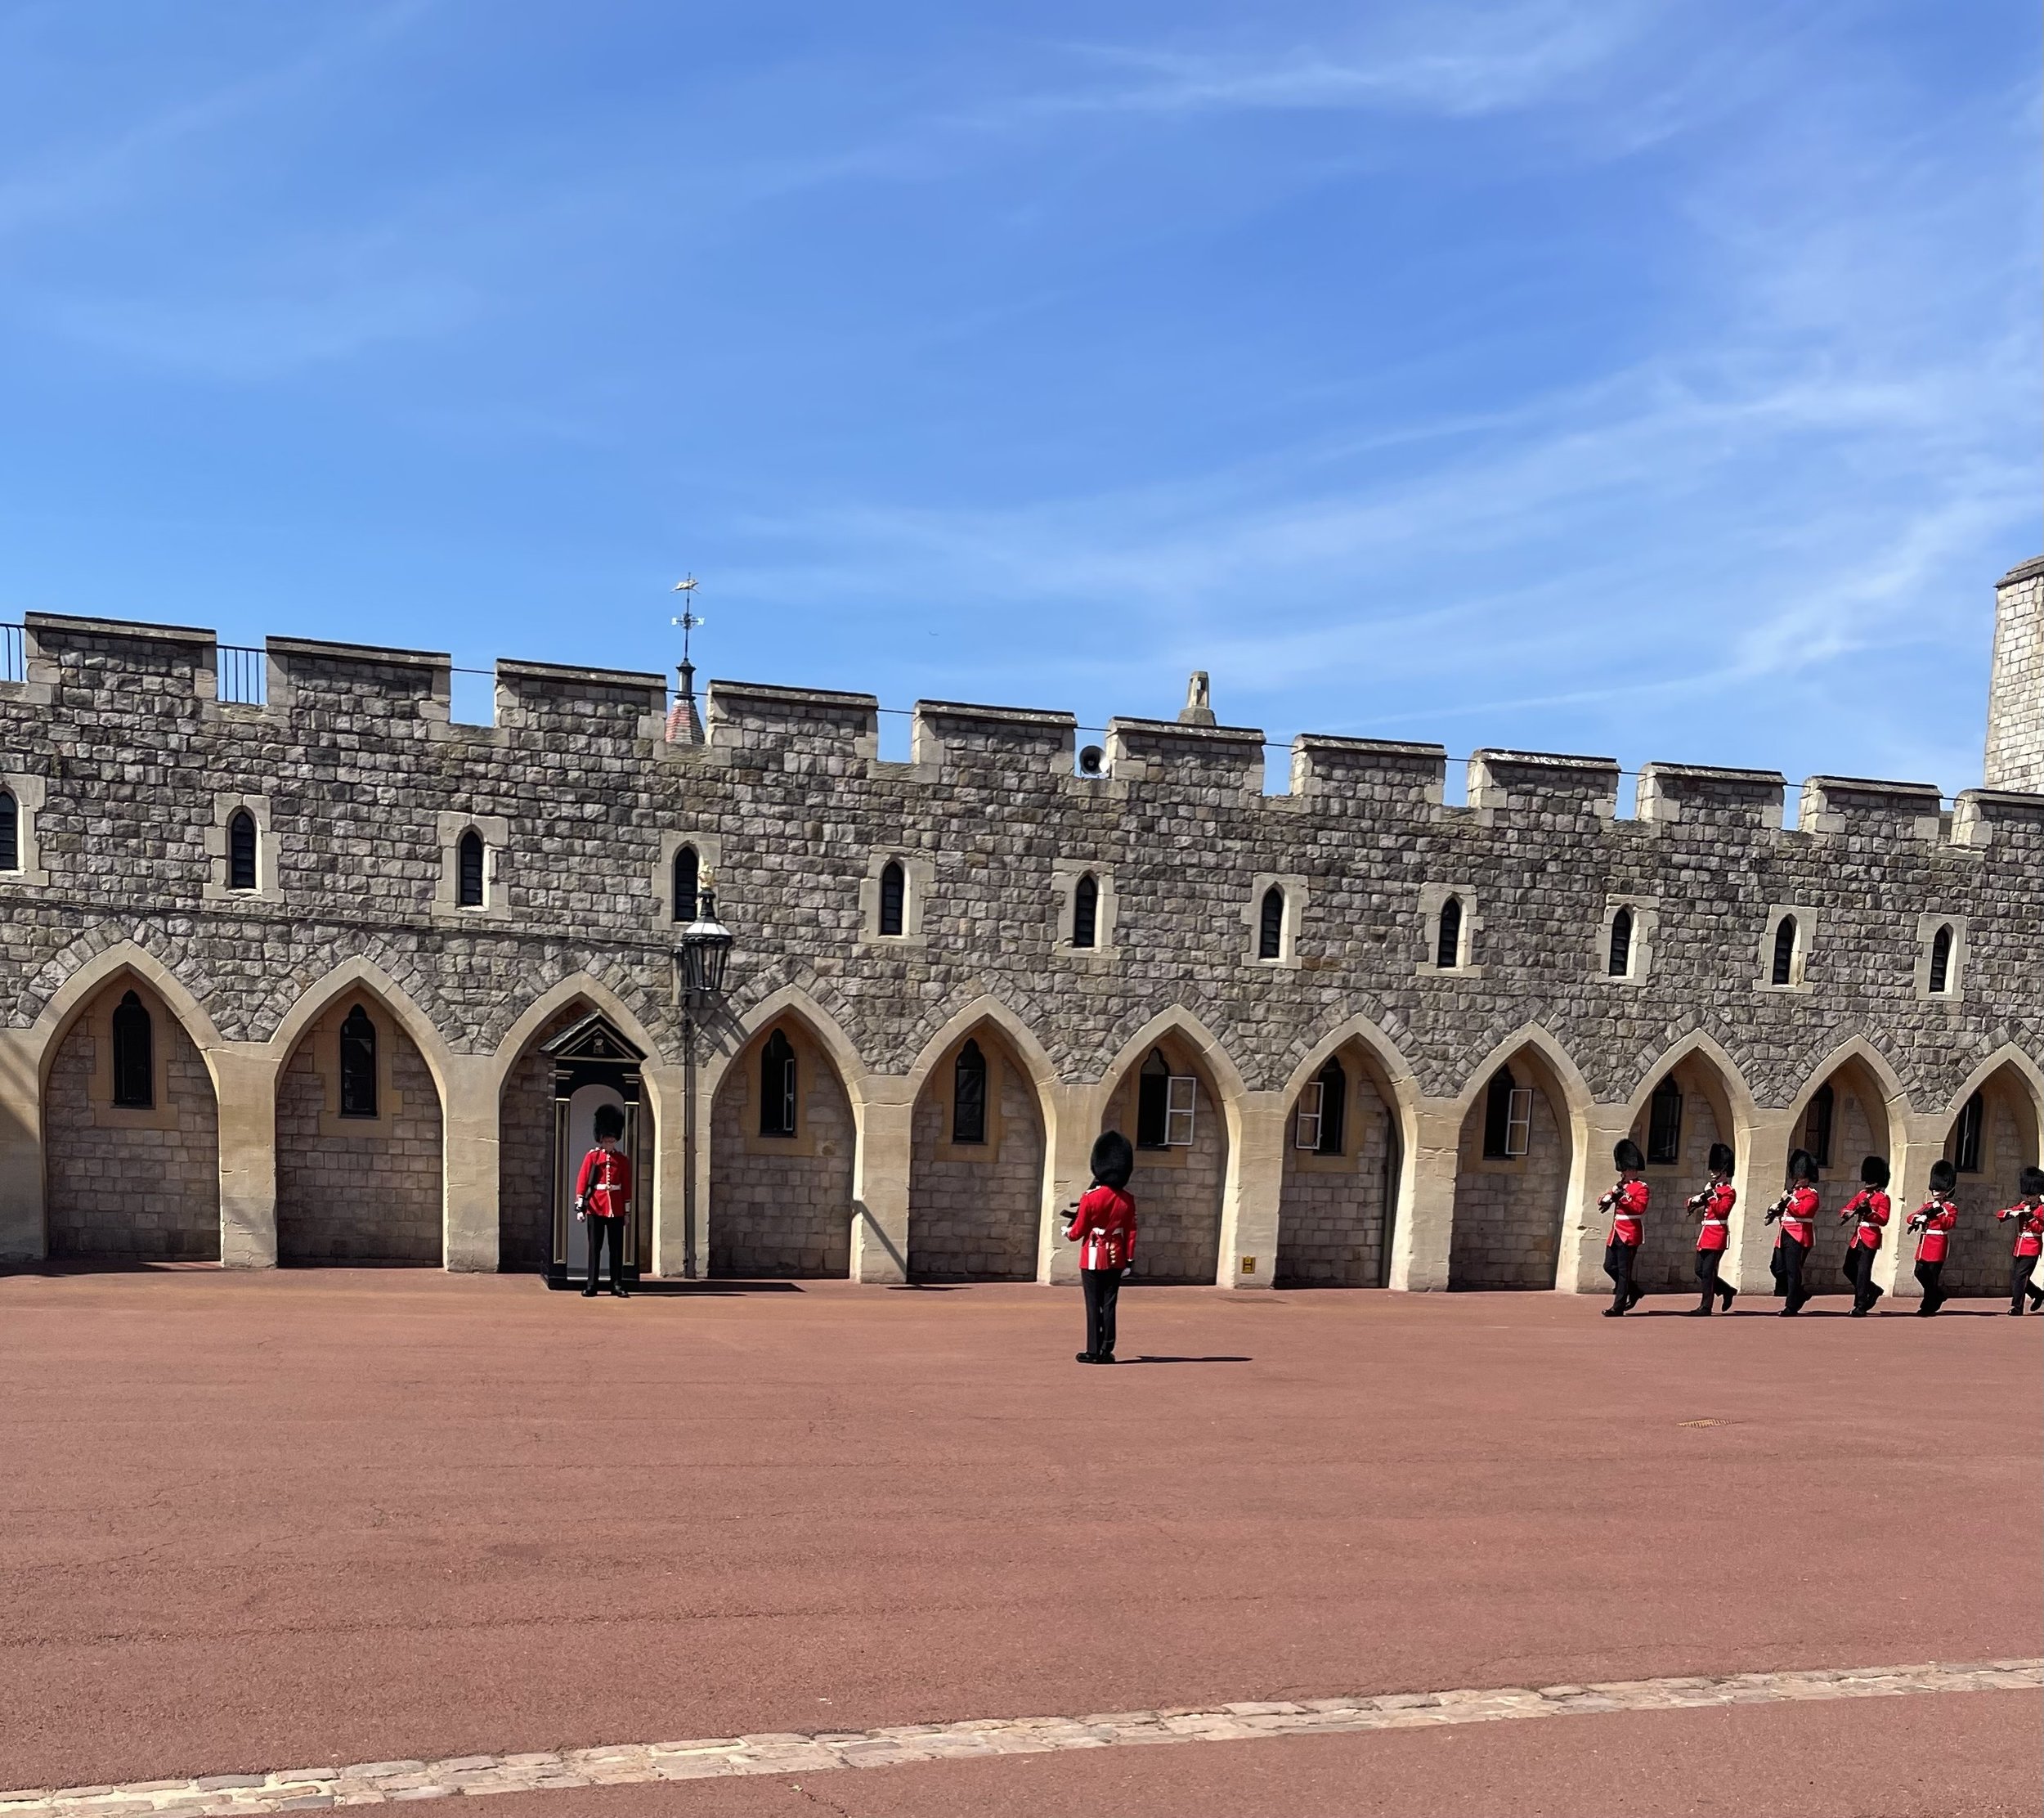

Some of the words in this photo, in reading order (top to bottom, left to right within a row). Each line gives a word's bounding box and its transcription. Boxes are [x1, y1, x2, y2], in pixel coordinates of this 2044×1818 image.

[671, 617, 677, 626] S
[697, 617, 705, 626] N
[1243, 1258, 1253, 1271] H
